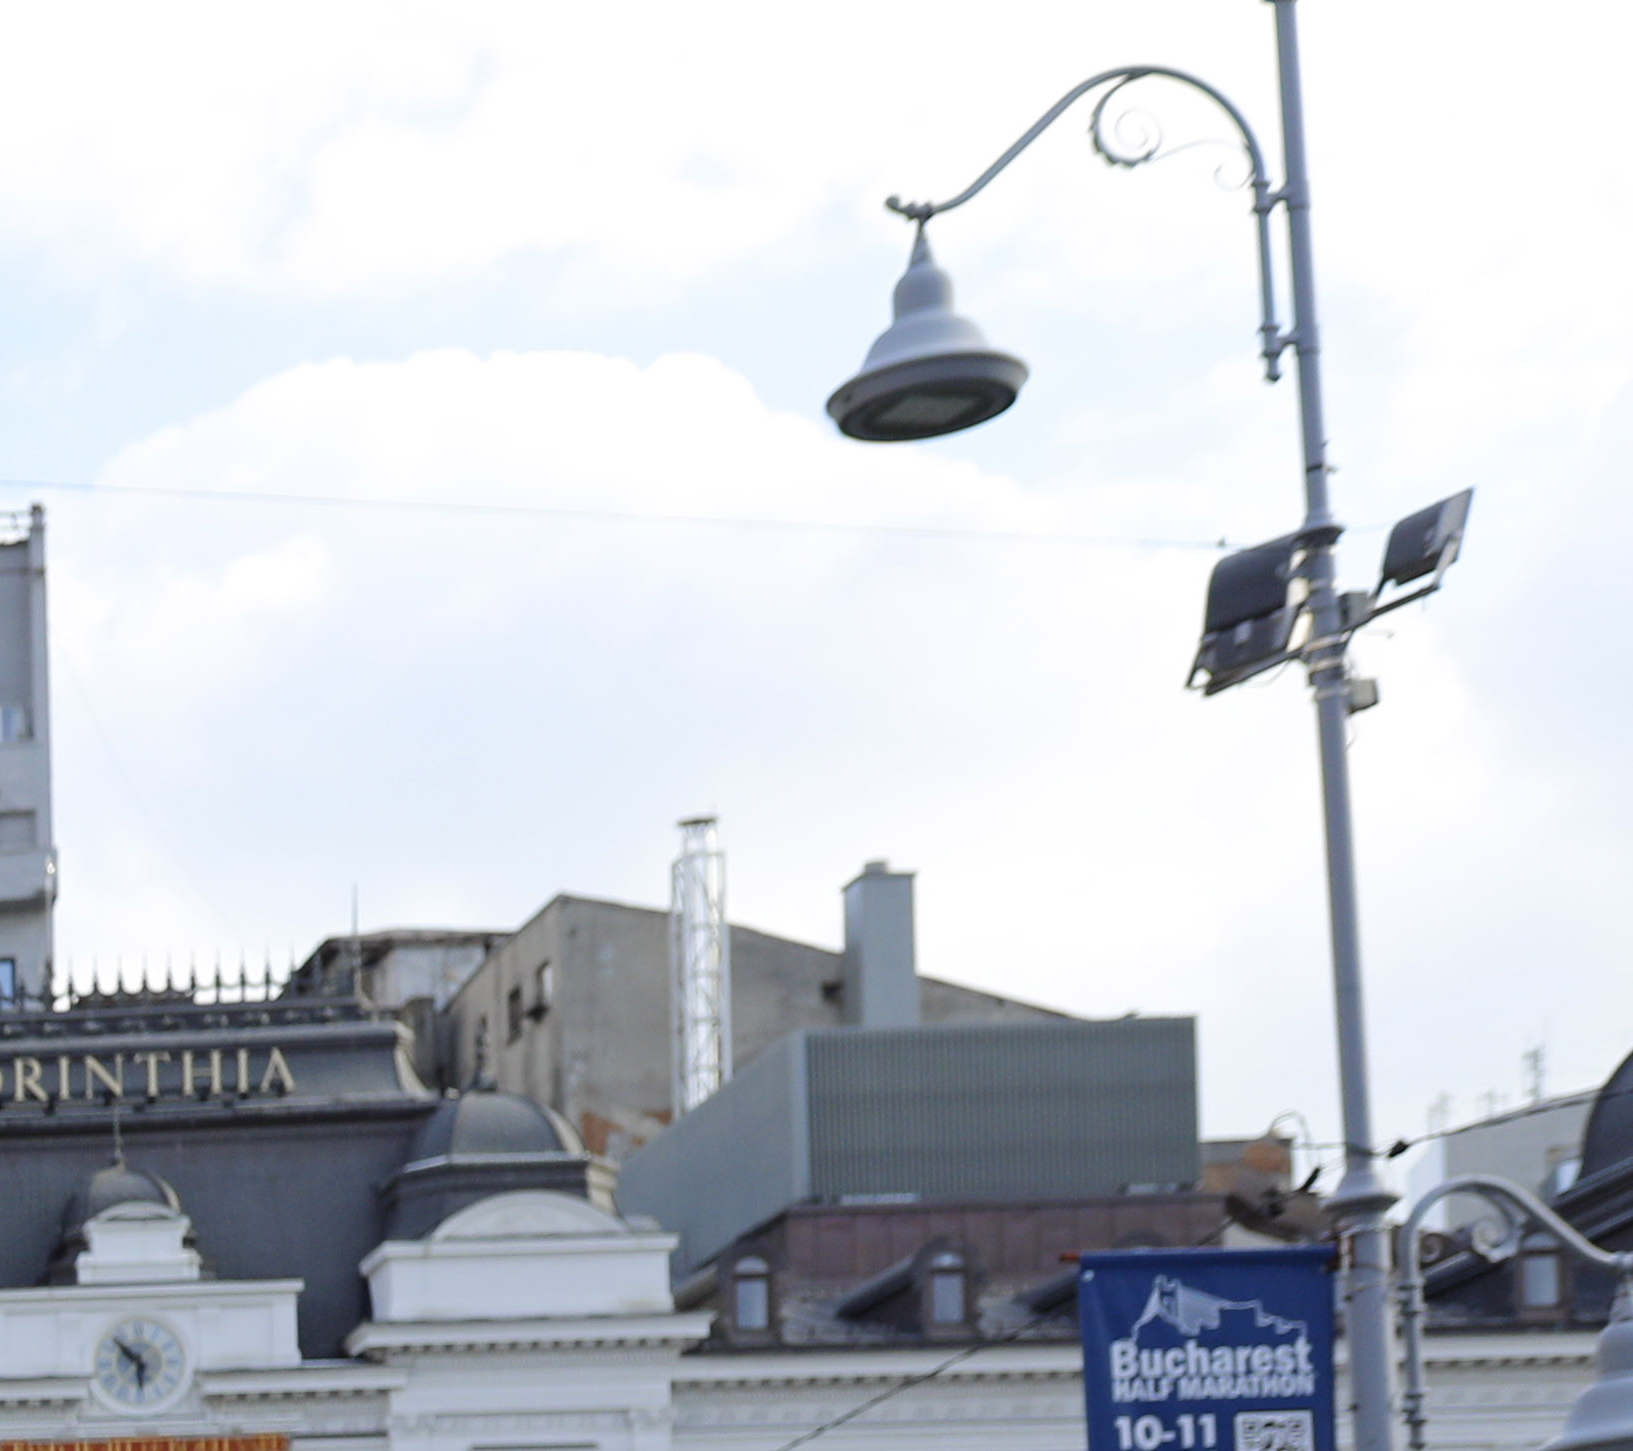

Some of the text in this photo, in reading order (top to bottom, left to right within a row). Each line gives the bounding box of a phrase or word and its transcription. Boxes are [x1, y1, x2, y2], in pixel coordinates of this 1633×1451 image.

[1111, 1334, 1314, 1379] Bucharest
[1112, 1374, 1315, 1402] HALF MARATHON
[1114, 1413, 1217, 1450] 10-11
